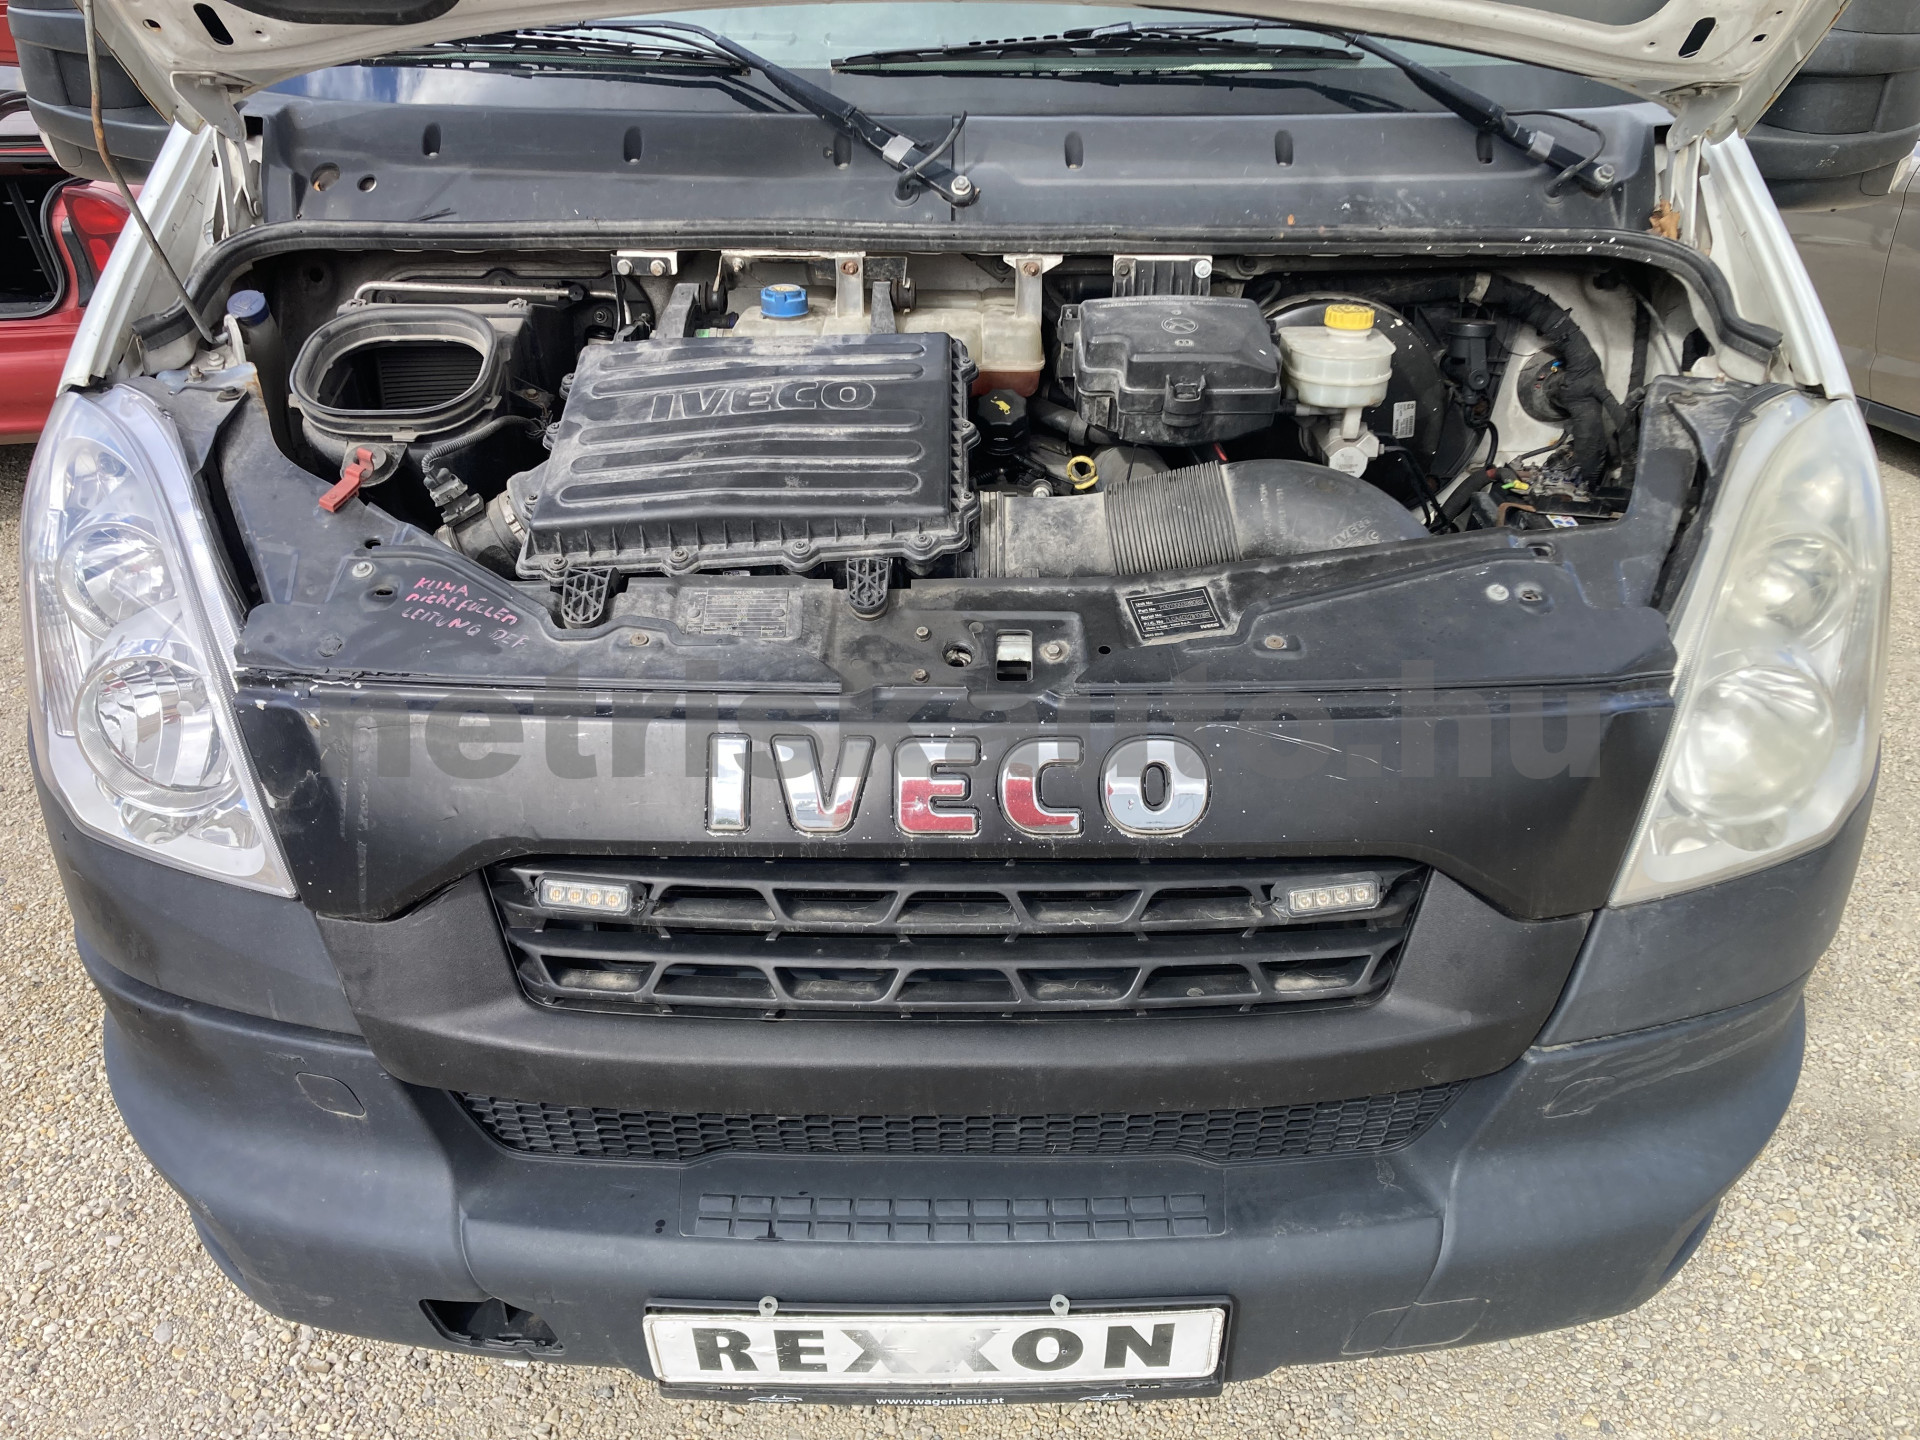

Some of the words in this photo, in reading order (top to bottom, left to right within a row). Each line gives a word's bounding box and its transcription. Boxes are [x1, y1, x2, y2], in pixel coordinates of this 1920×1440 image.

[651, 381, 876, 422] IVECO
[413, 577, 469, 598] KLIMA
[401, 606, 482, 637] LEITUNG
[705, 733, 1212, 838] IVECO
[875, 1396, 1005, 1407] www.wagenhaus.at
